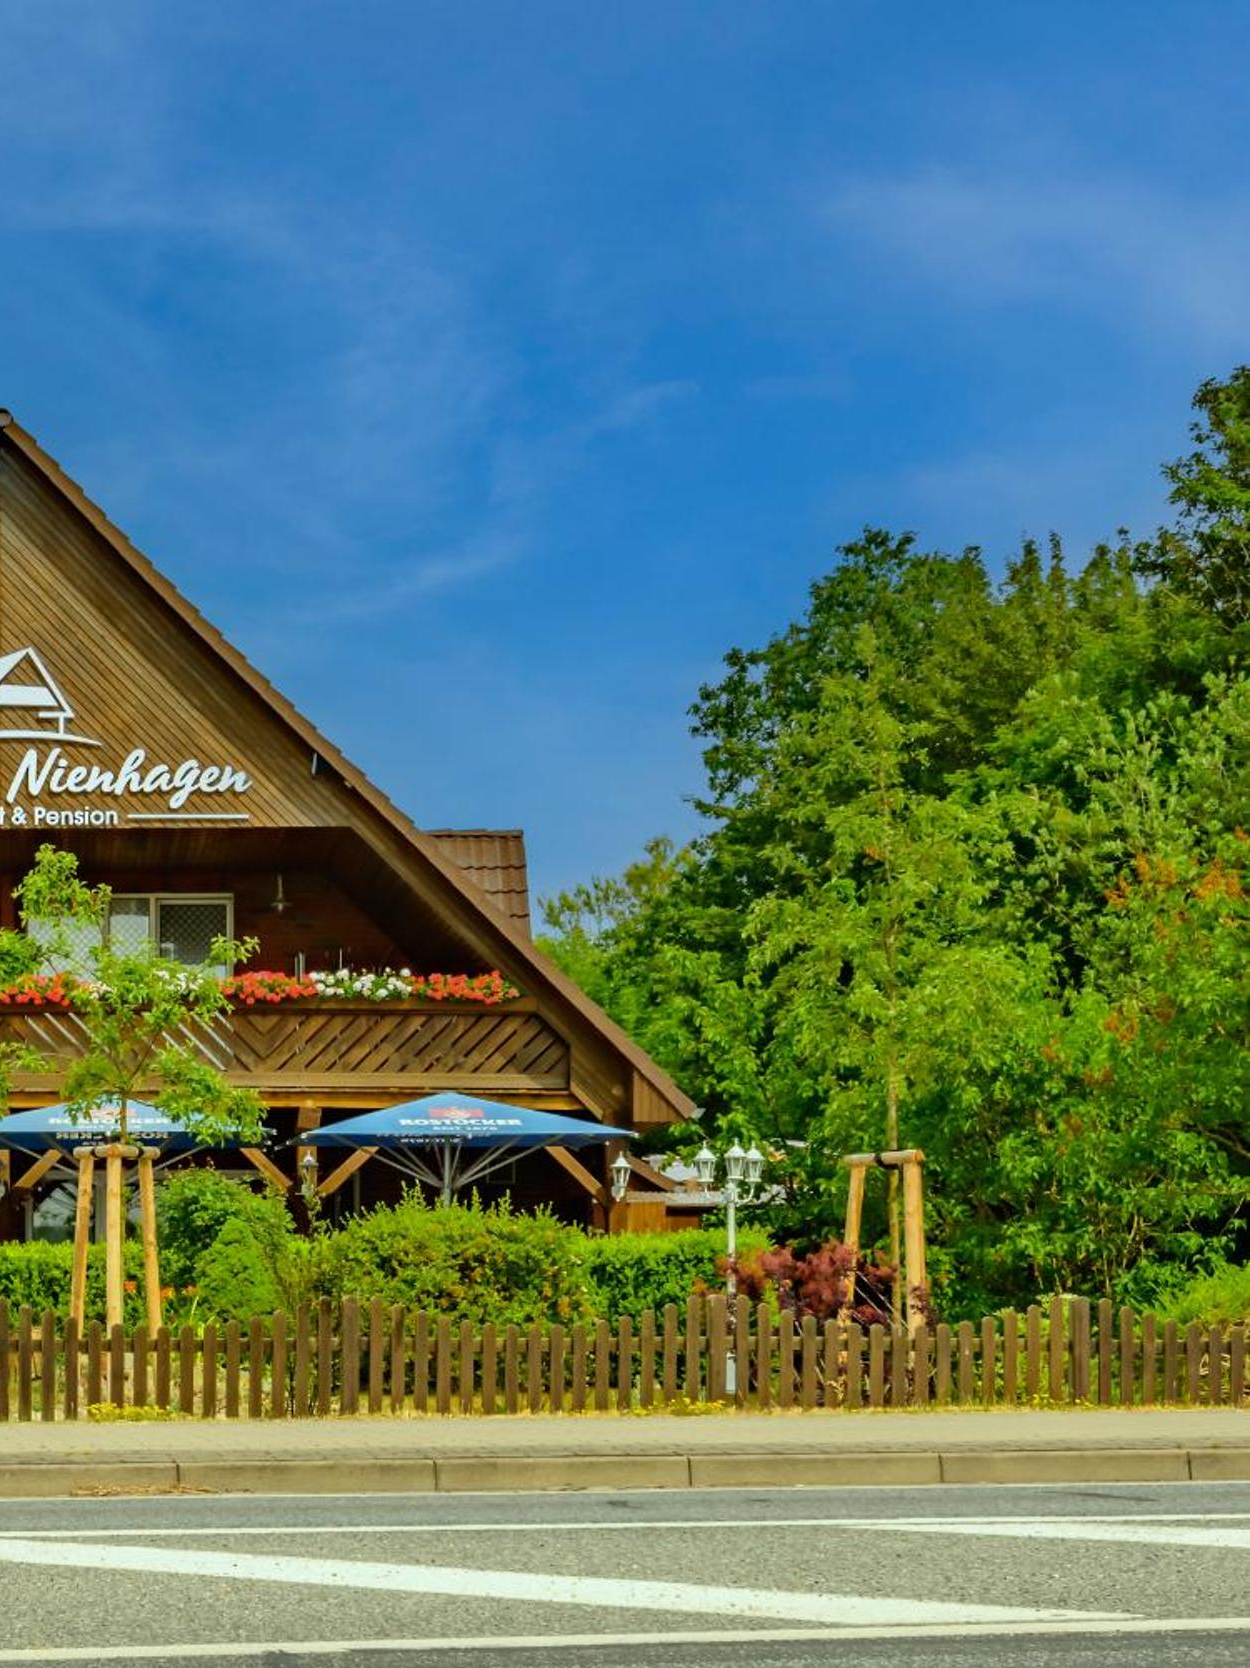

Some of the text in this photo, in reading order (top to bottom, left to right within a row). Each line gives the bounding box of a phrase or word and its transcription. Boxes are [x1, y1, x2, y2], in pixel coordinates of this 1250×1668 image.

[6, 747, 252, 809] Nienhagen
[11, 807, 28, 825] &
[34, 806, 118, 826] Pension
[398, 1118, 523, 1127] ROSTOCKER
